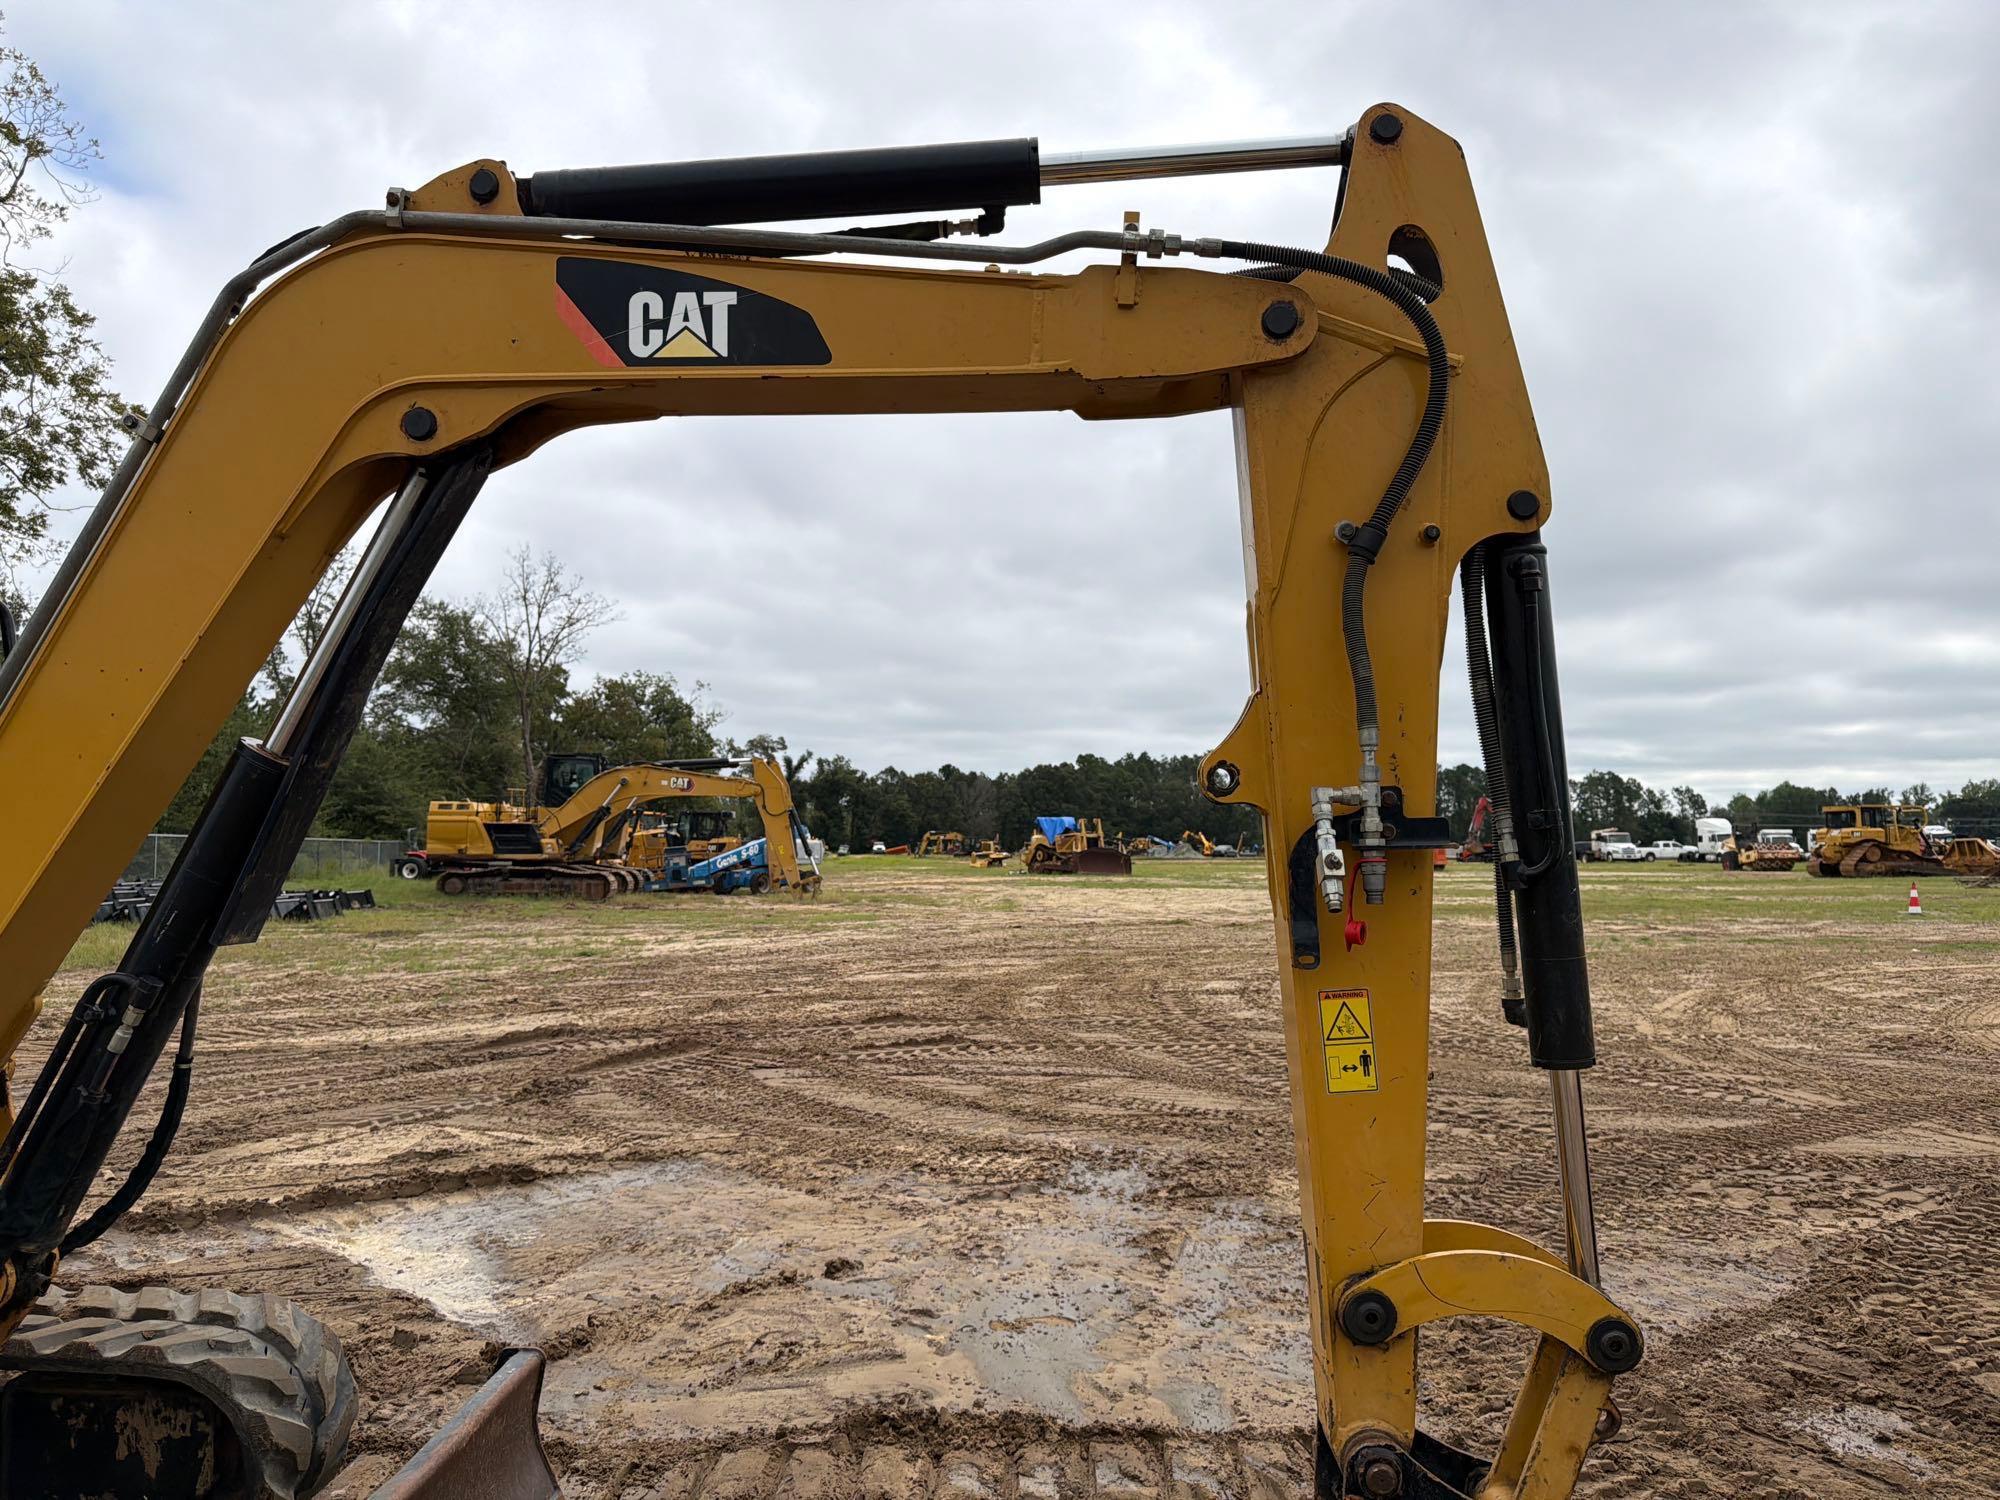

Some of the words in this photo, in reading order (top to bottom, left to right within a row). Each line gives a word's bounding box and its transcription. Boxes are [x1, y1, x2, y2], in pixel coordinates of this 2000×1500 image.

[628, 291, 738, 358] CAT
[670, 777, 689, 789] CAT
[716, 854, 738, 868] Genie
[741, 844, 759, 860] S-60
[1331, 991, 1364, 1000] WARNING
